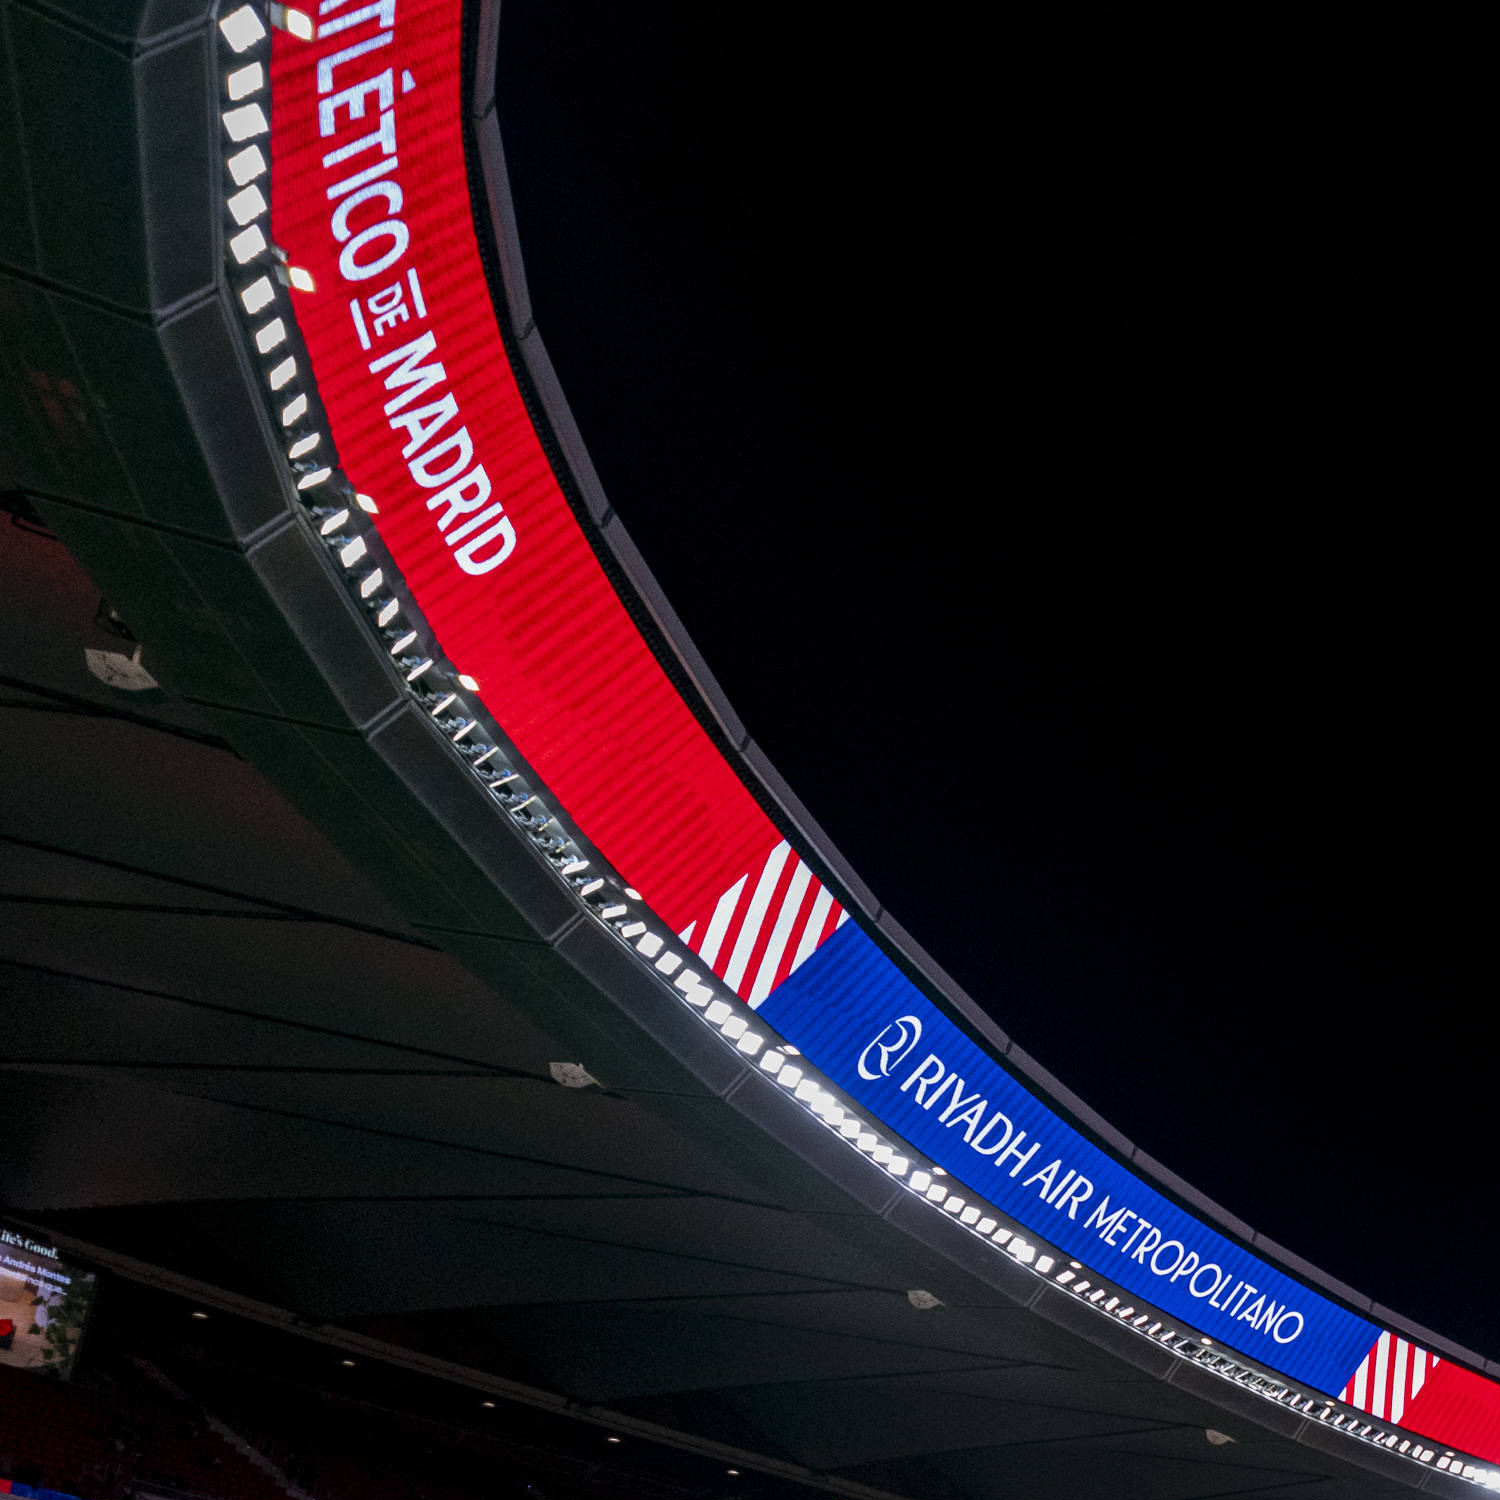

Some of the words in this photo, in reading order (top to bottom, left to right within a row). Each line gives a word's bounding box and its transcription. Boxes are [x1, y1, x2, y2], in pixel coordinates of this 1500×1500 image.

[367, 281, 410, 336] DE
[368, 330, 517, 576] MADRID
[900, 1053, 1042, 1178] RIYADH
[1022, 1156, 1094, 1220] AIR
[1084, 1194, 1304, 1344] METROPOLITANO
